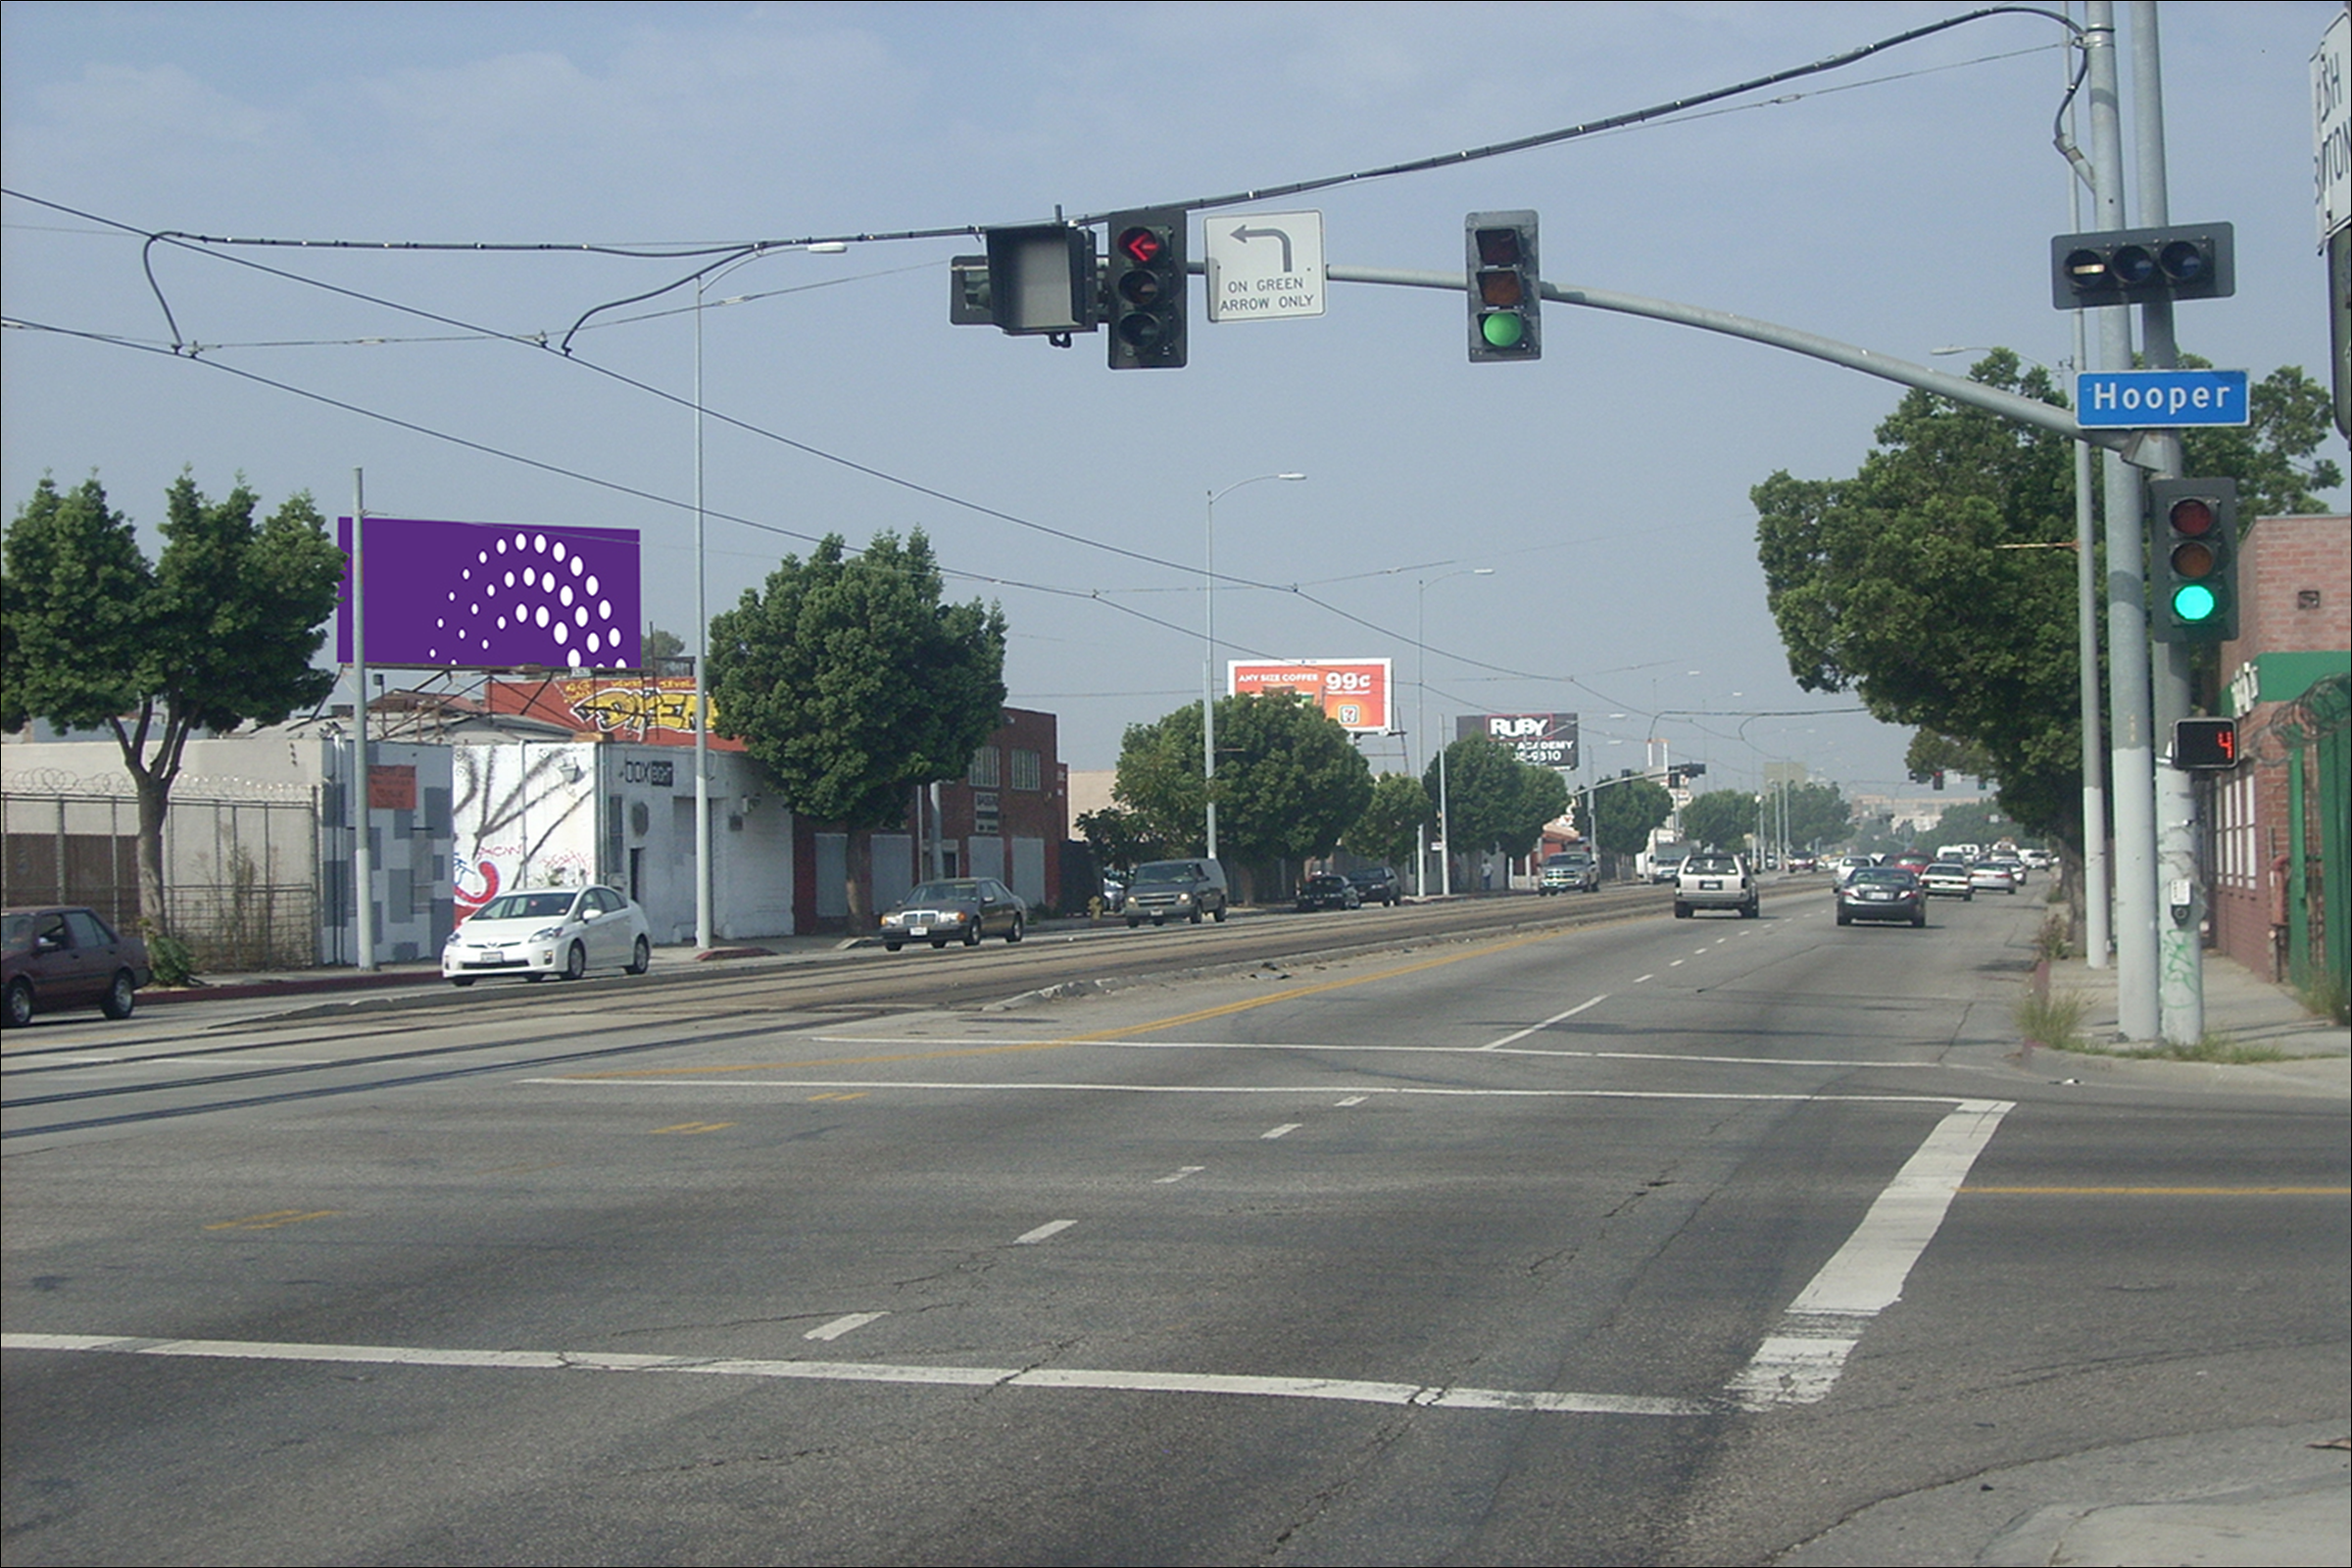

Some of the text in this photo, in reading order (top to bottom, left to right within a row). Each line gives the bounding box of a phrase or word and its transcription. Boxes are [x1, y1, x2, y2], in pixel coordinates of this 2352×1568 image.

[1227, 276, 1304, 294] ON GREEN
[1219, 294, 1315, 312] ARROW ONLY
[2093, 381, 2231, 416] Hooper
[1238, 673, 1259, 683] ANY
[1260, 673, 1281, 682] SIZE
[1282, 673, 1319, 683] COFFEE
[1490, 717, 1548, 737] RUBY
[2217, 731, 2234, 760] 4
